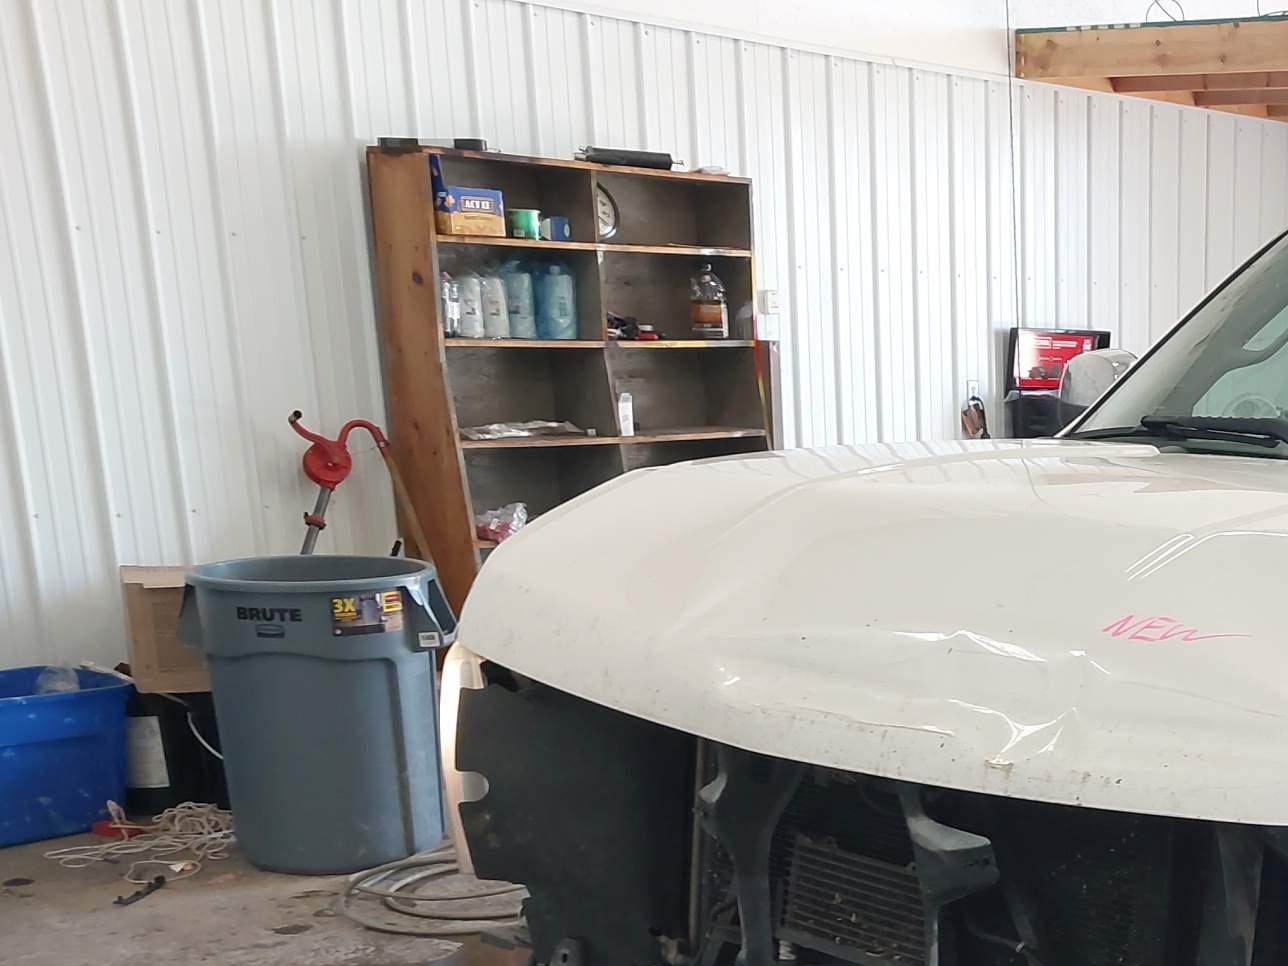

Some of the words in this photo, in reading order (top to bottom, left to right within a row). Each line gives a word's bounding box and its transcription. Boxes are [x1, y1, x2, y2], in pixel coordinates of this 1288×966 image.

[332, 598, 357, 613] 3X
[236, 606, 303, 622] BRUTE
[1103, 613, 1252, 643] NEW
